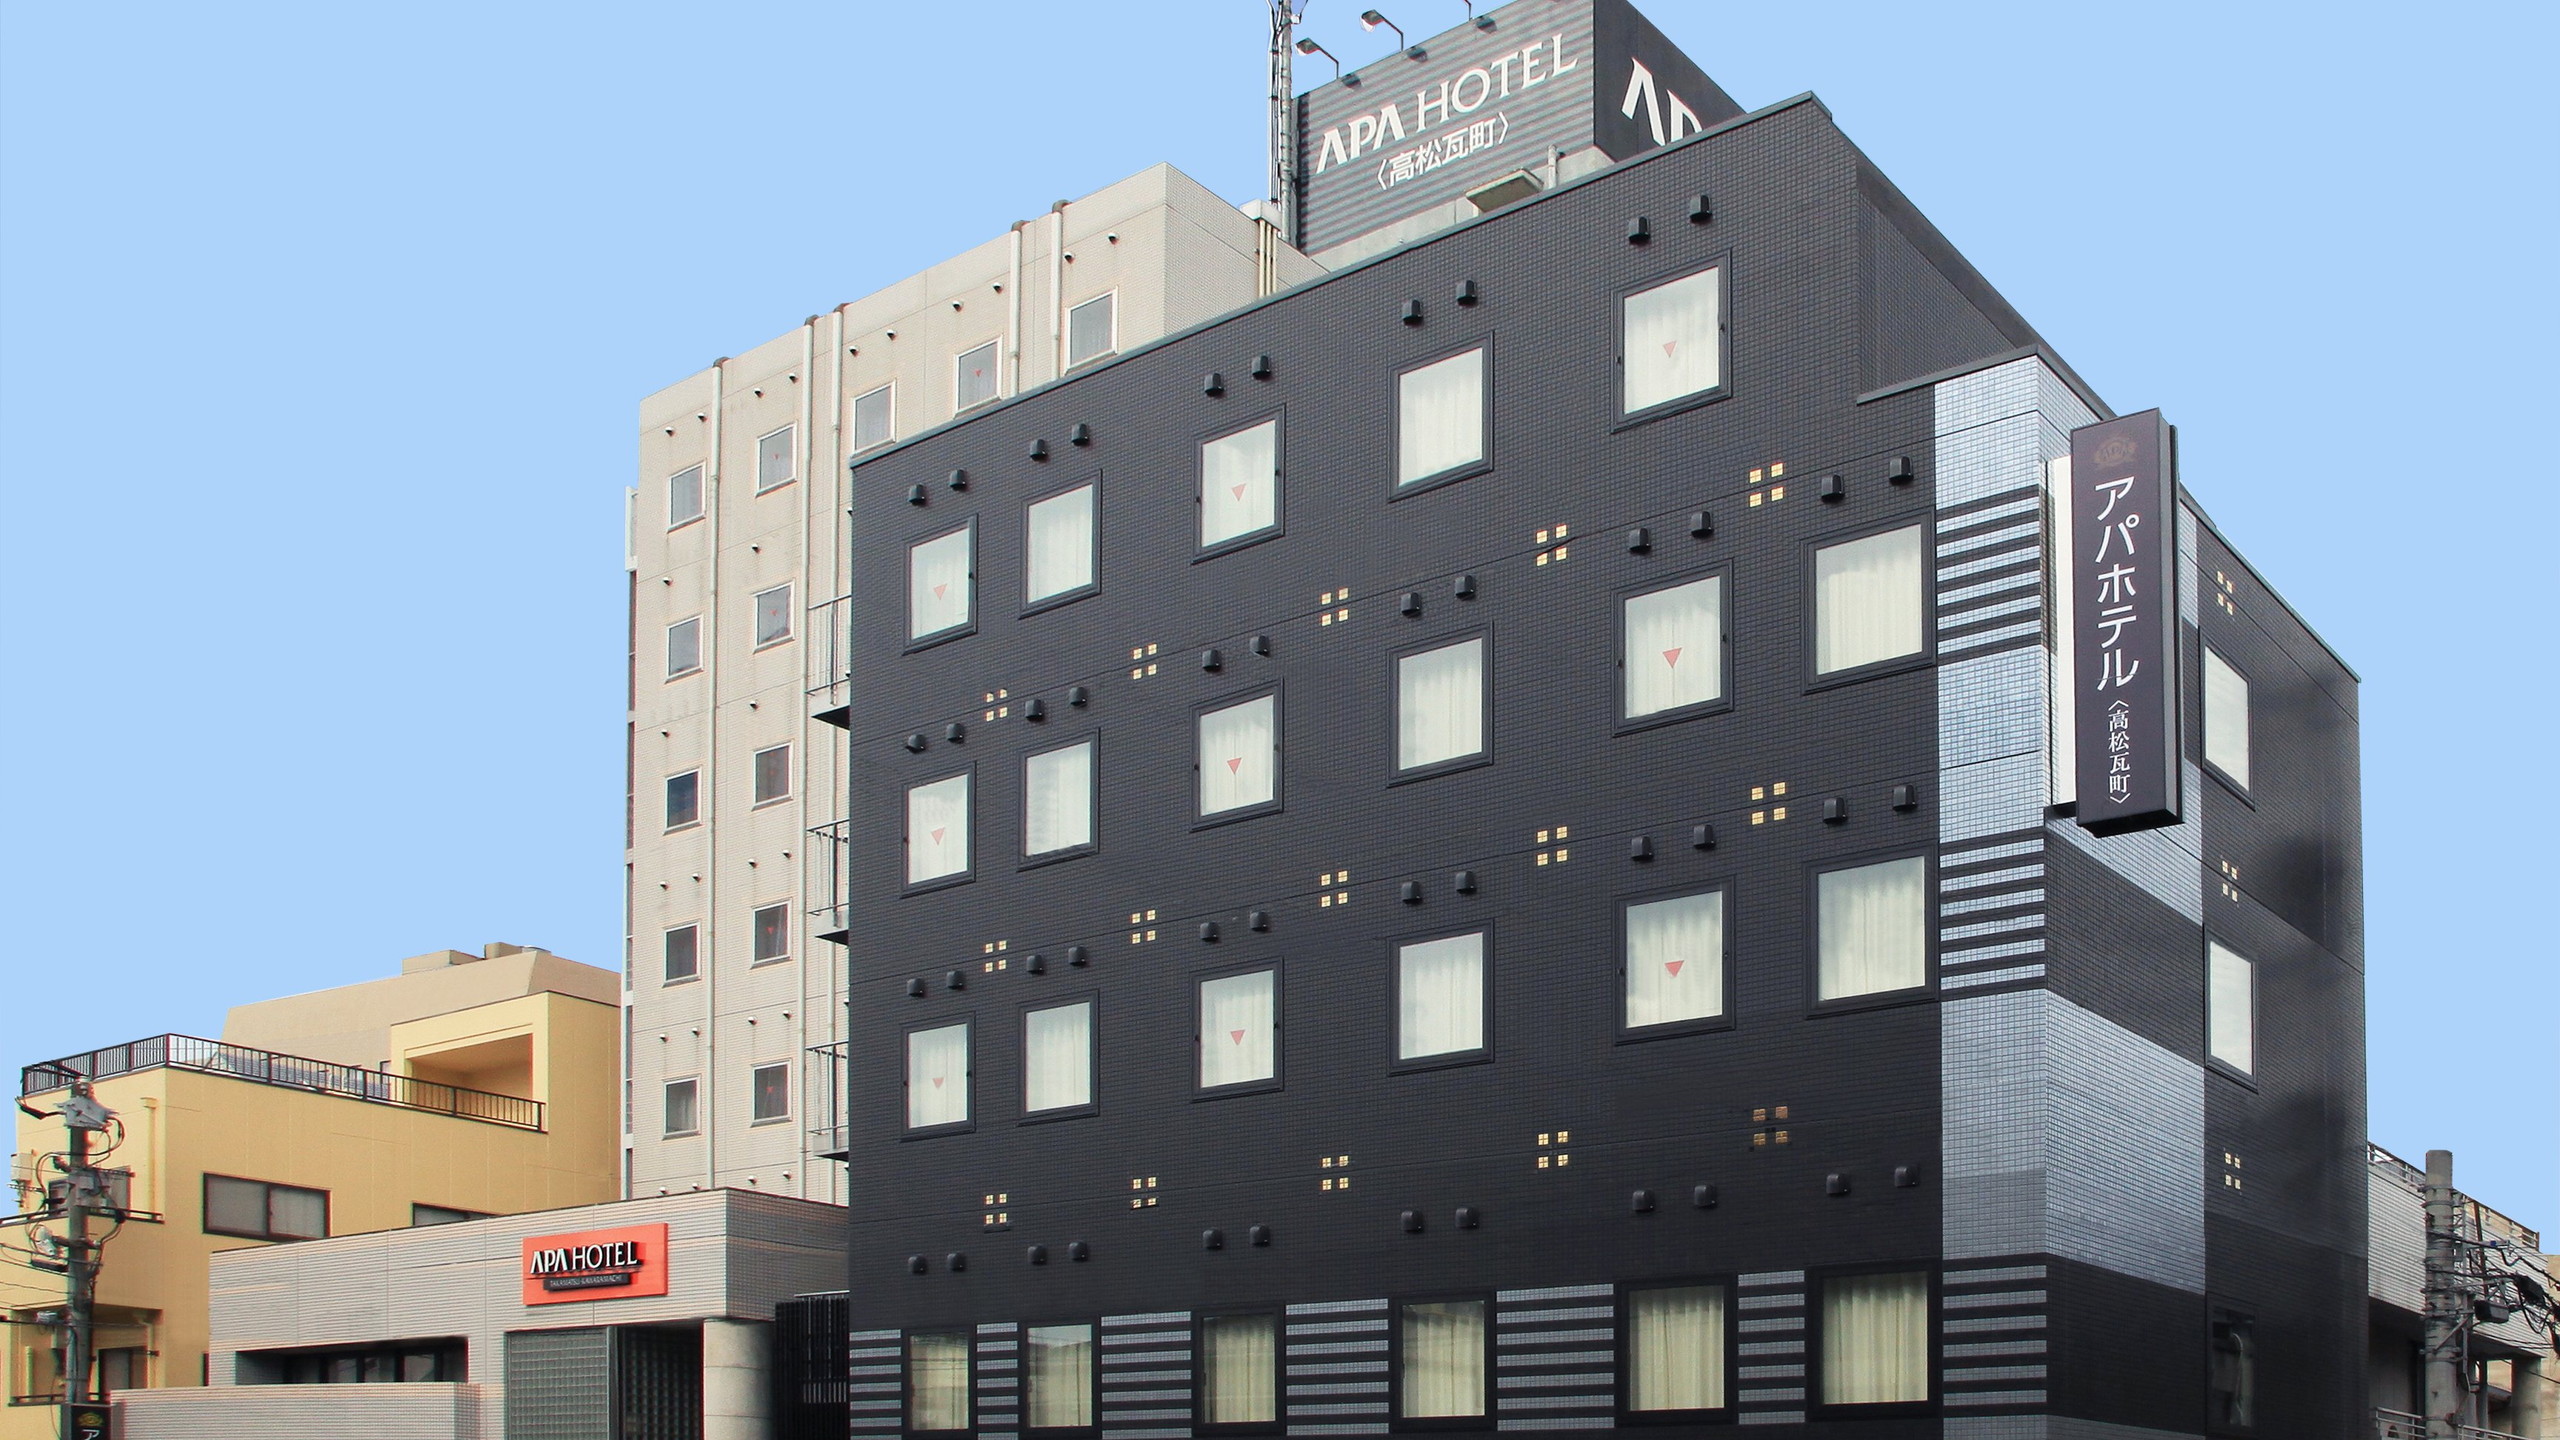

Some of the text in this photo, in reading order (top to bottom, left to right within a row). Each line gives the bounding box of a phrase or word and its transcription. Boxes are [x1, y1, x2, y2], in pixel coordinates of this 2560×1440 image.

[1316, 33, 1579, 174] APA HOTEL
[2095, 476, 2140, 691] アパホテル
[530, 1241, 638, 1274] APA HOTEL
